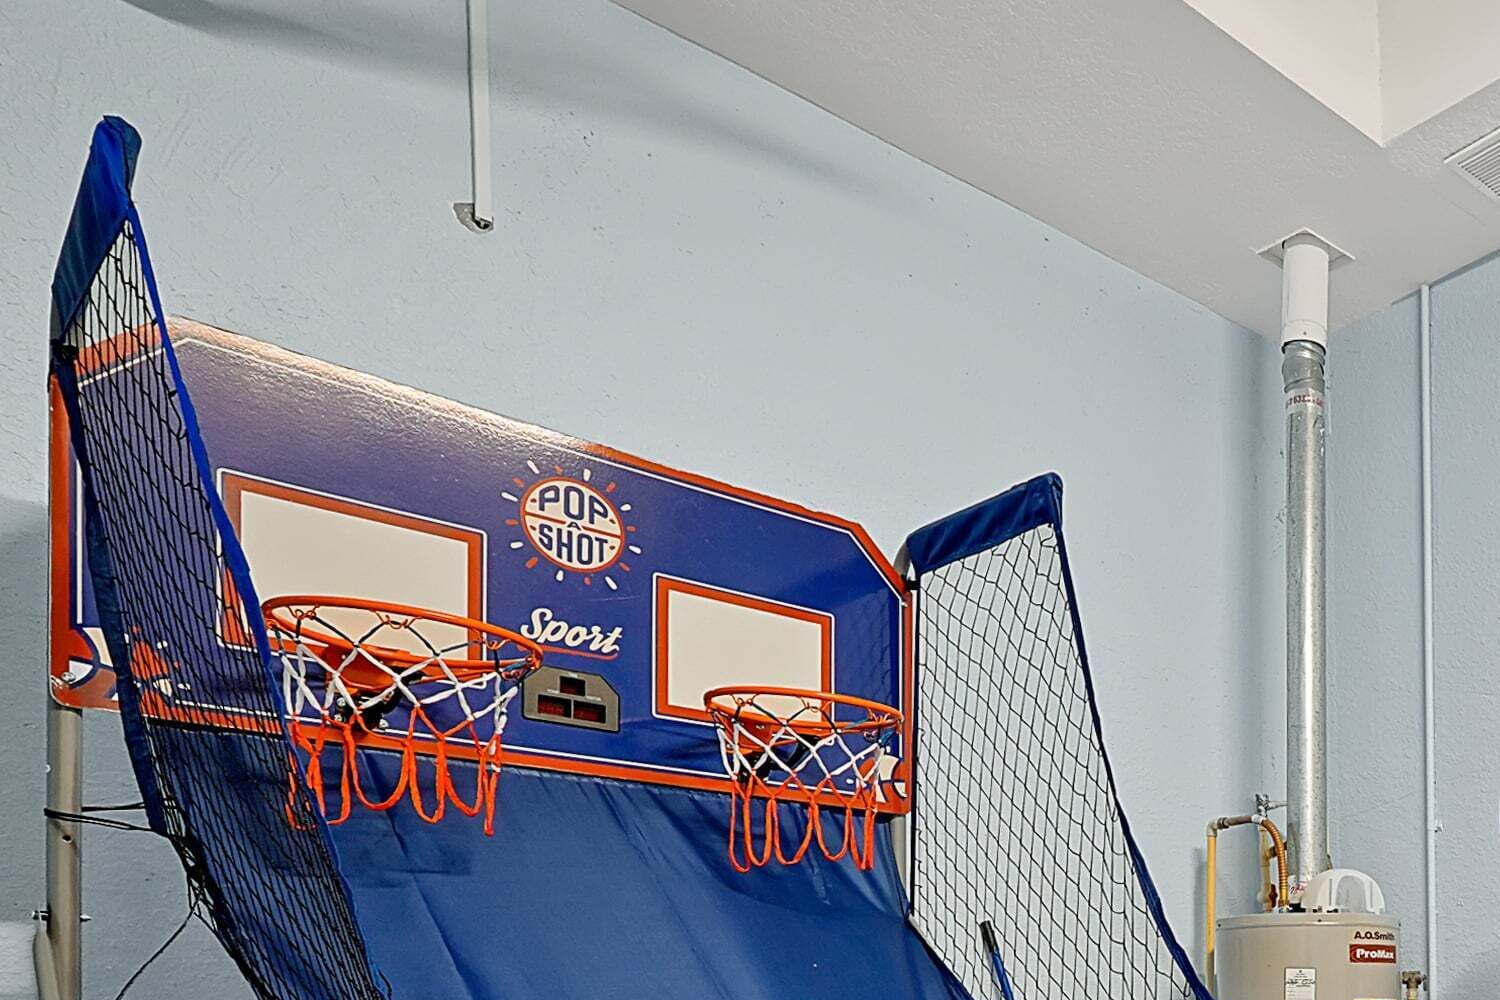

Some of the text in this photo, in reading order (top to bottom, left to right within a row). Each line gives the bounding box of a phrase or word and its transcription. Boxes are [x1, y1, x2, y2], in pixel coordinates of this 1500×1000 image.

[538, 484, 609, 525] POP
[538, 523, 609, 566] SHOT
[566, 521, 582, 531] A
[520, 607, 623, 654] Sport
[1356, 948, 1394, 959] ProMax
